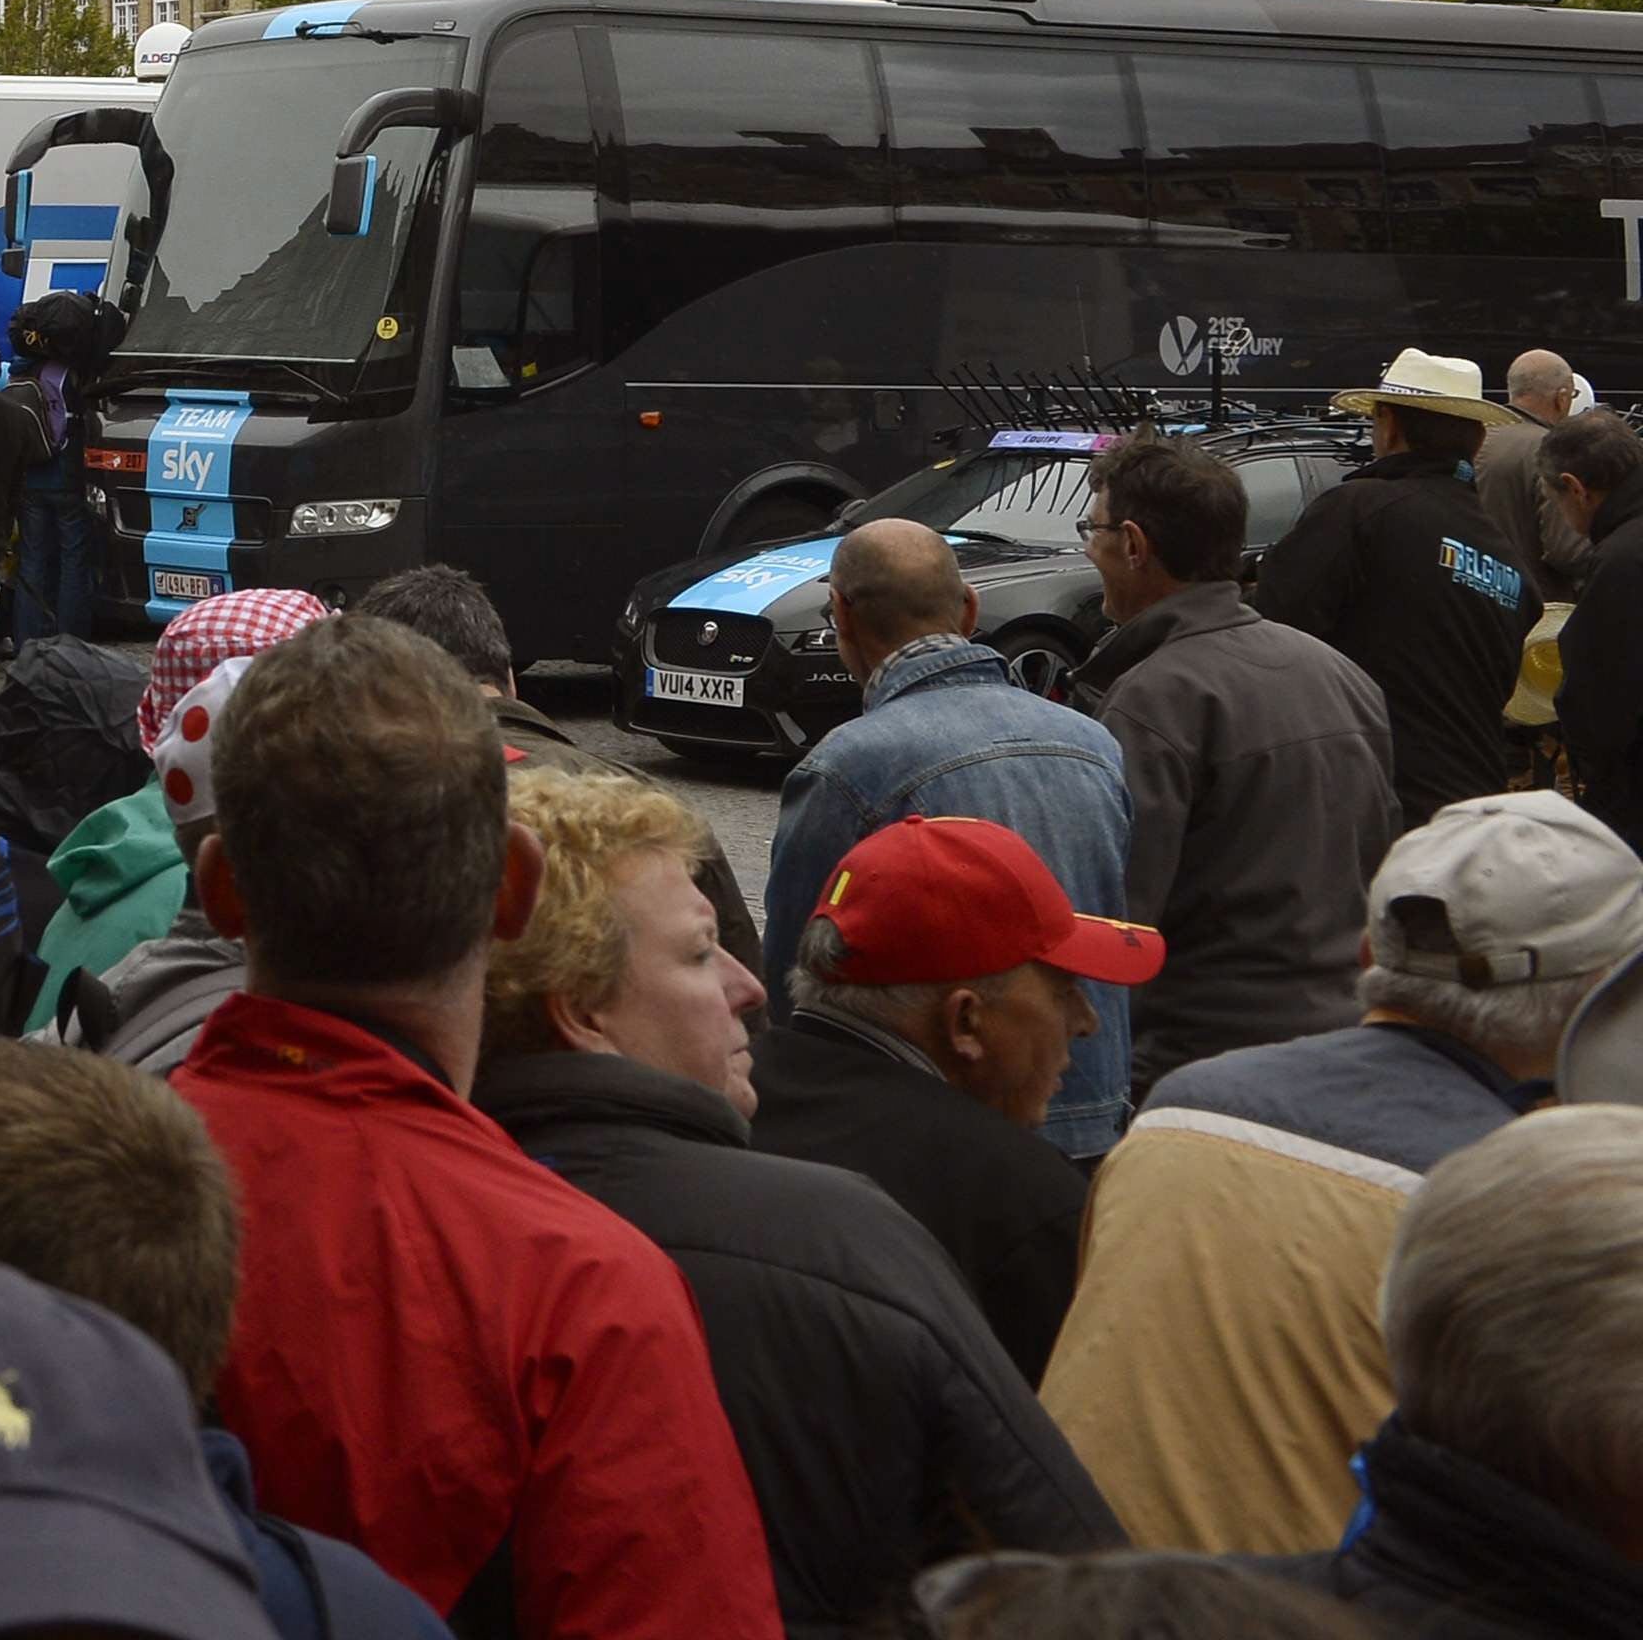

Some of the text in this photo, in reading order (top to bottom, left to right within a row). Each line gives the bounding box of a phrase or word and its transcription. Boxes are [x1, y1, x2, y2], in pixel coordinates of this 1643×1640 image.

[1208, 337, 1284, 356] CETURY
[173, 408, 236, 429] TEAM
[161, 440, 215, 491] sky
[758, 551, 821, 568] TEAM
[715, 566, 790, 591] sky
[658, 672, 735, 701] VU14 XXR
